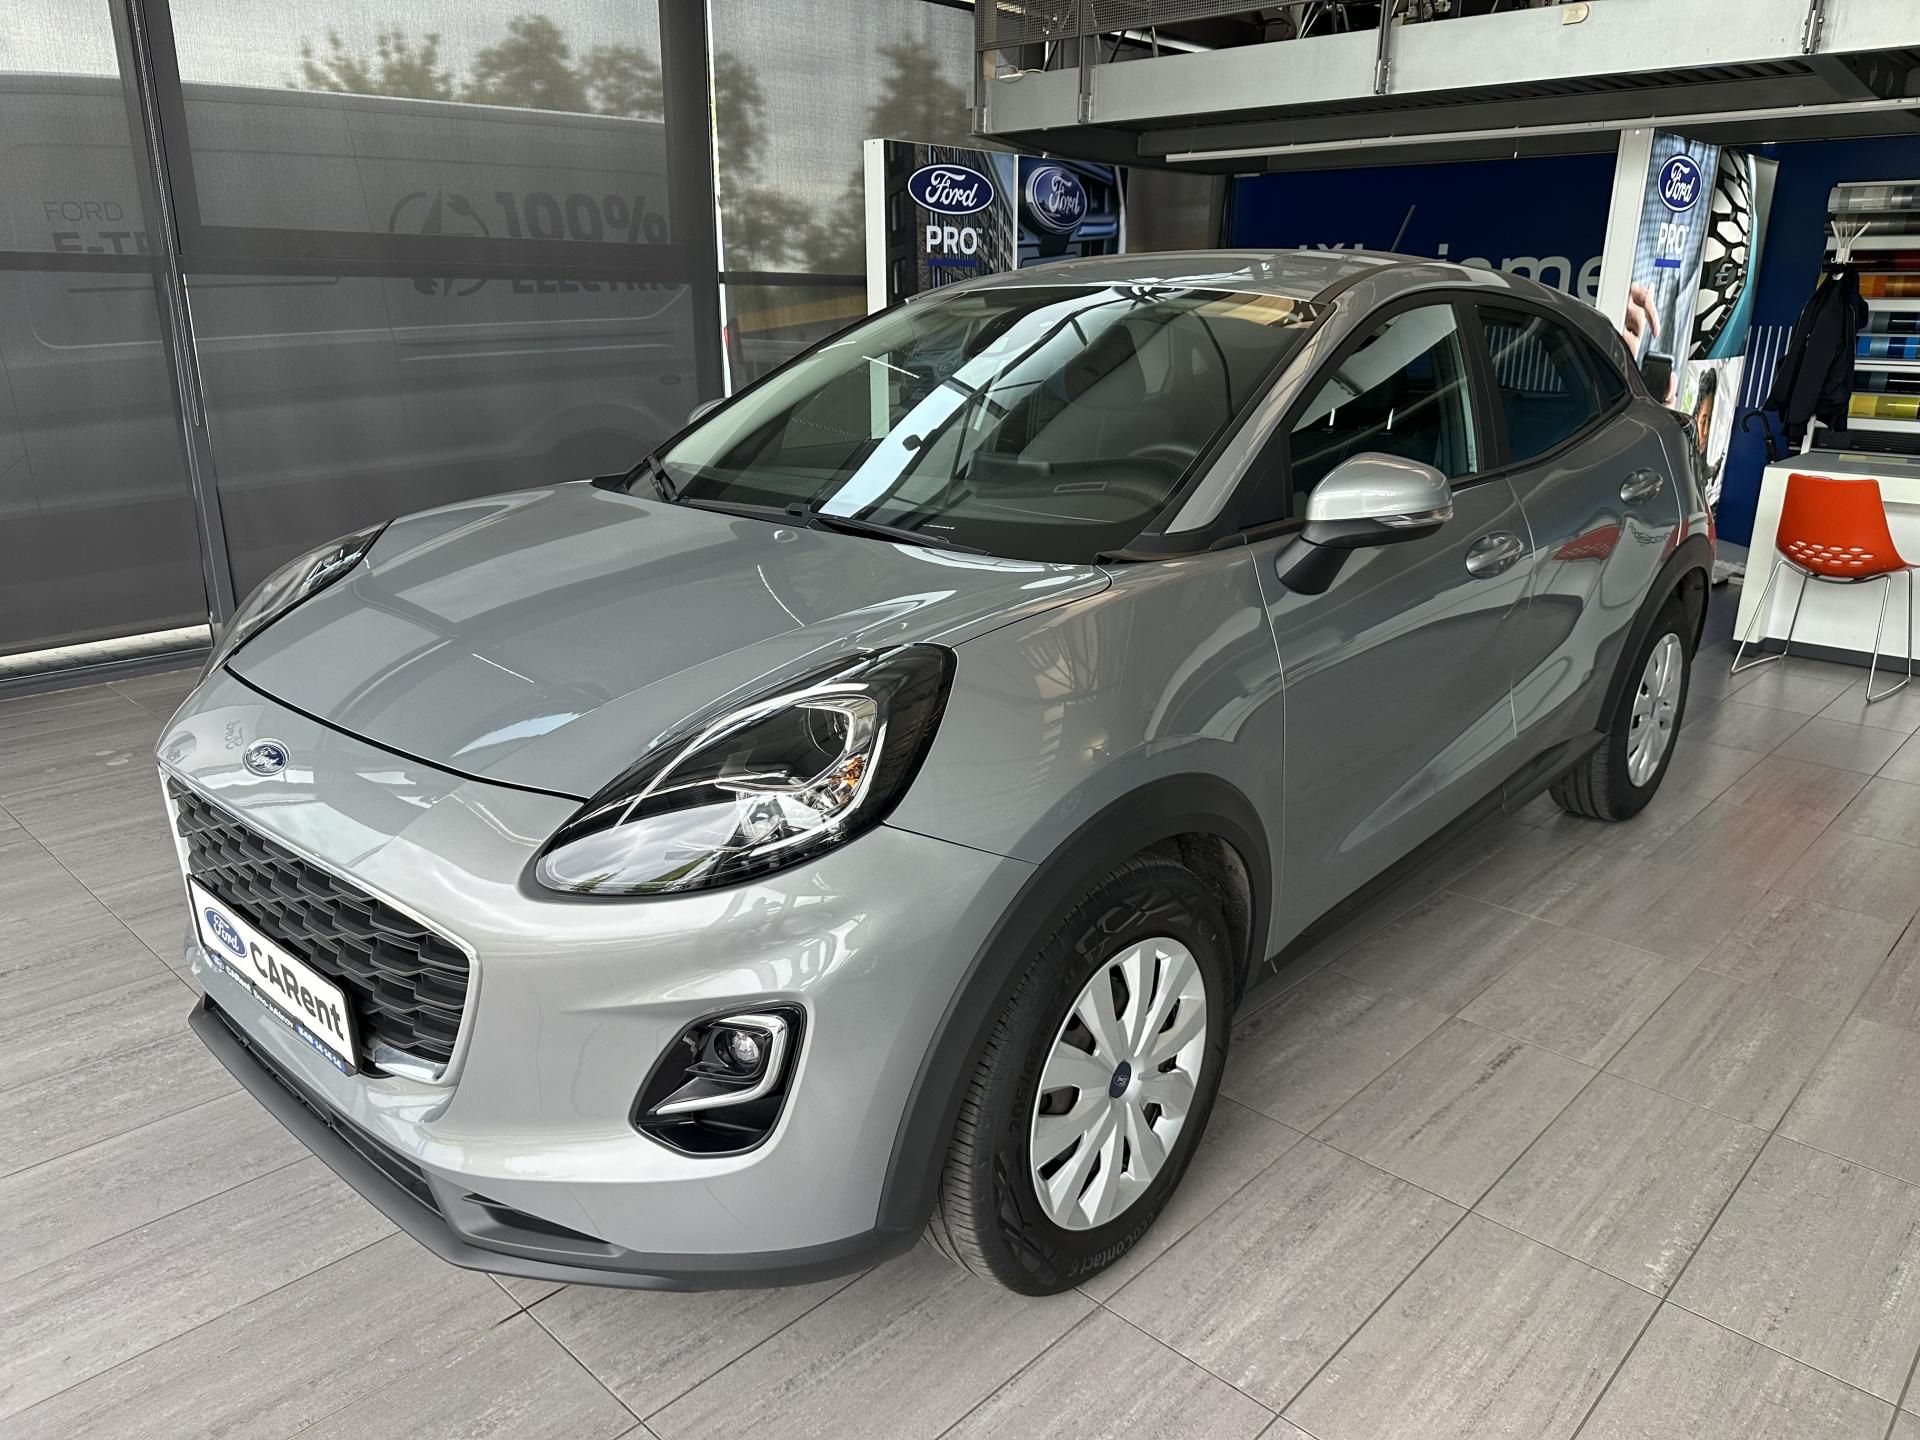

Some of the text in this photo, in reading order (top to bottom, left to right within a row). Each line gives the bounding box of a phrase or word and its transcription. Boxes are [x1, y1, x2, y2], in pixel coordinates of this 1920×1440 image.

[925, 170, 978, 207] Ford
[1048, 175, 1081, 214] Ford
[1665, 162, 1696, 203] Ford
[43, 201, 124, 222] FORD
[494, 191, 671, 243] 100%
[213, 913, 240, 951] Ford
[250, 941, 345, 1042] CARent
